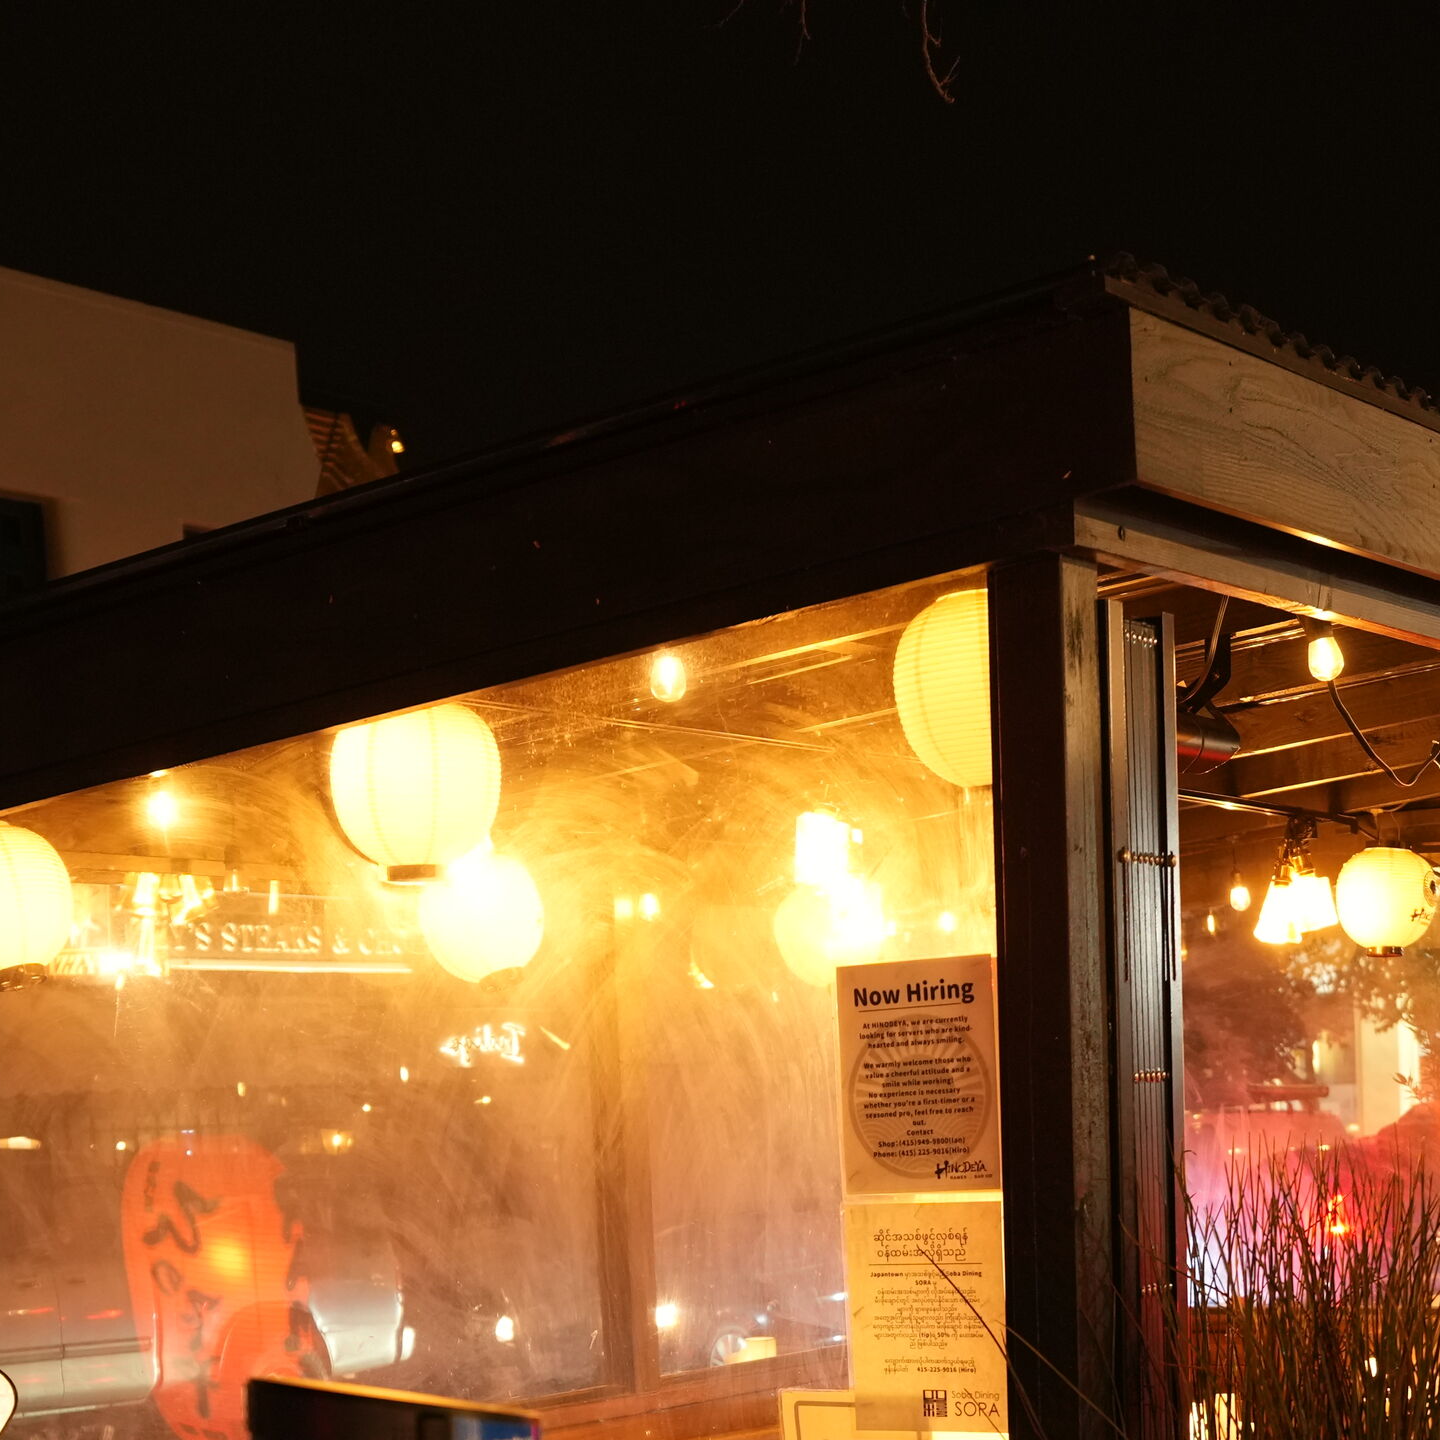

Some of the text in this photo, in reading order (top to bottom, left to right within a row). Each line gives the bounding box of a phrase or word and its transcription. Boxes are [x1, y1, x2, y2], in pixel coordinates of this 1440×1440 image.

[854, 979, 974, 1007] Now Hiring
[936, 1016, 968, 1024] currently
[911, 1038, 934, 1046] always
[879, 1090, 916, 1098] experience
[952, 1391, 999, 1401] Soba Dining
[955, 1402, 1000, 1417] SORA
